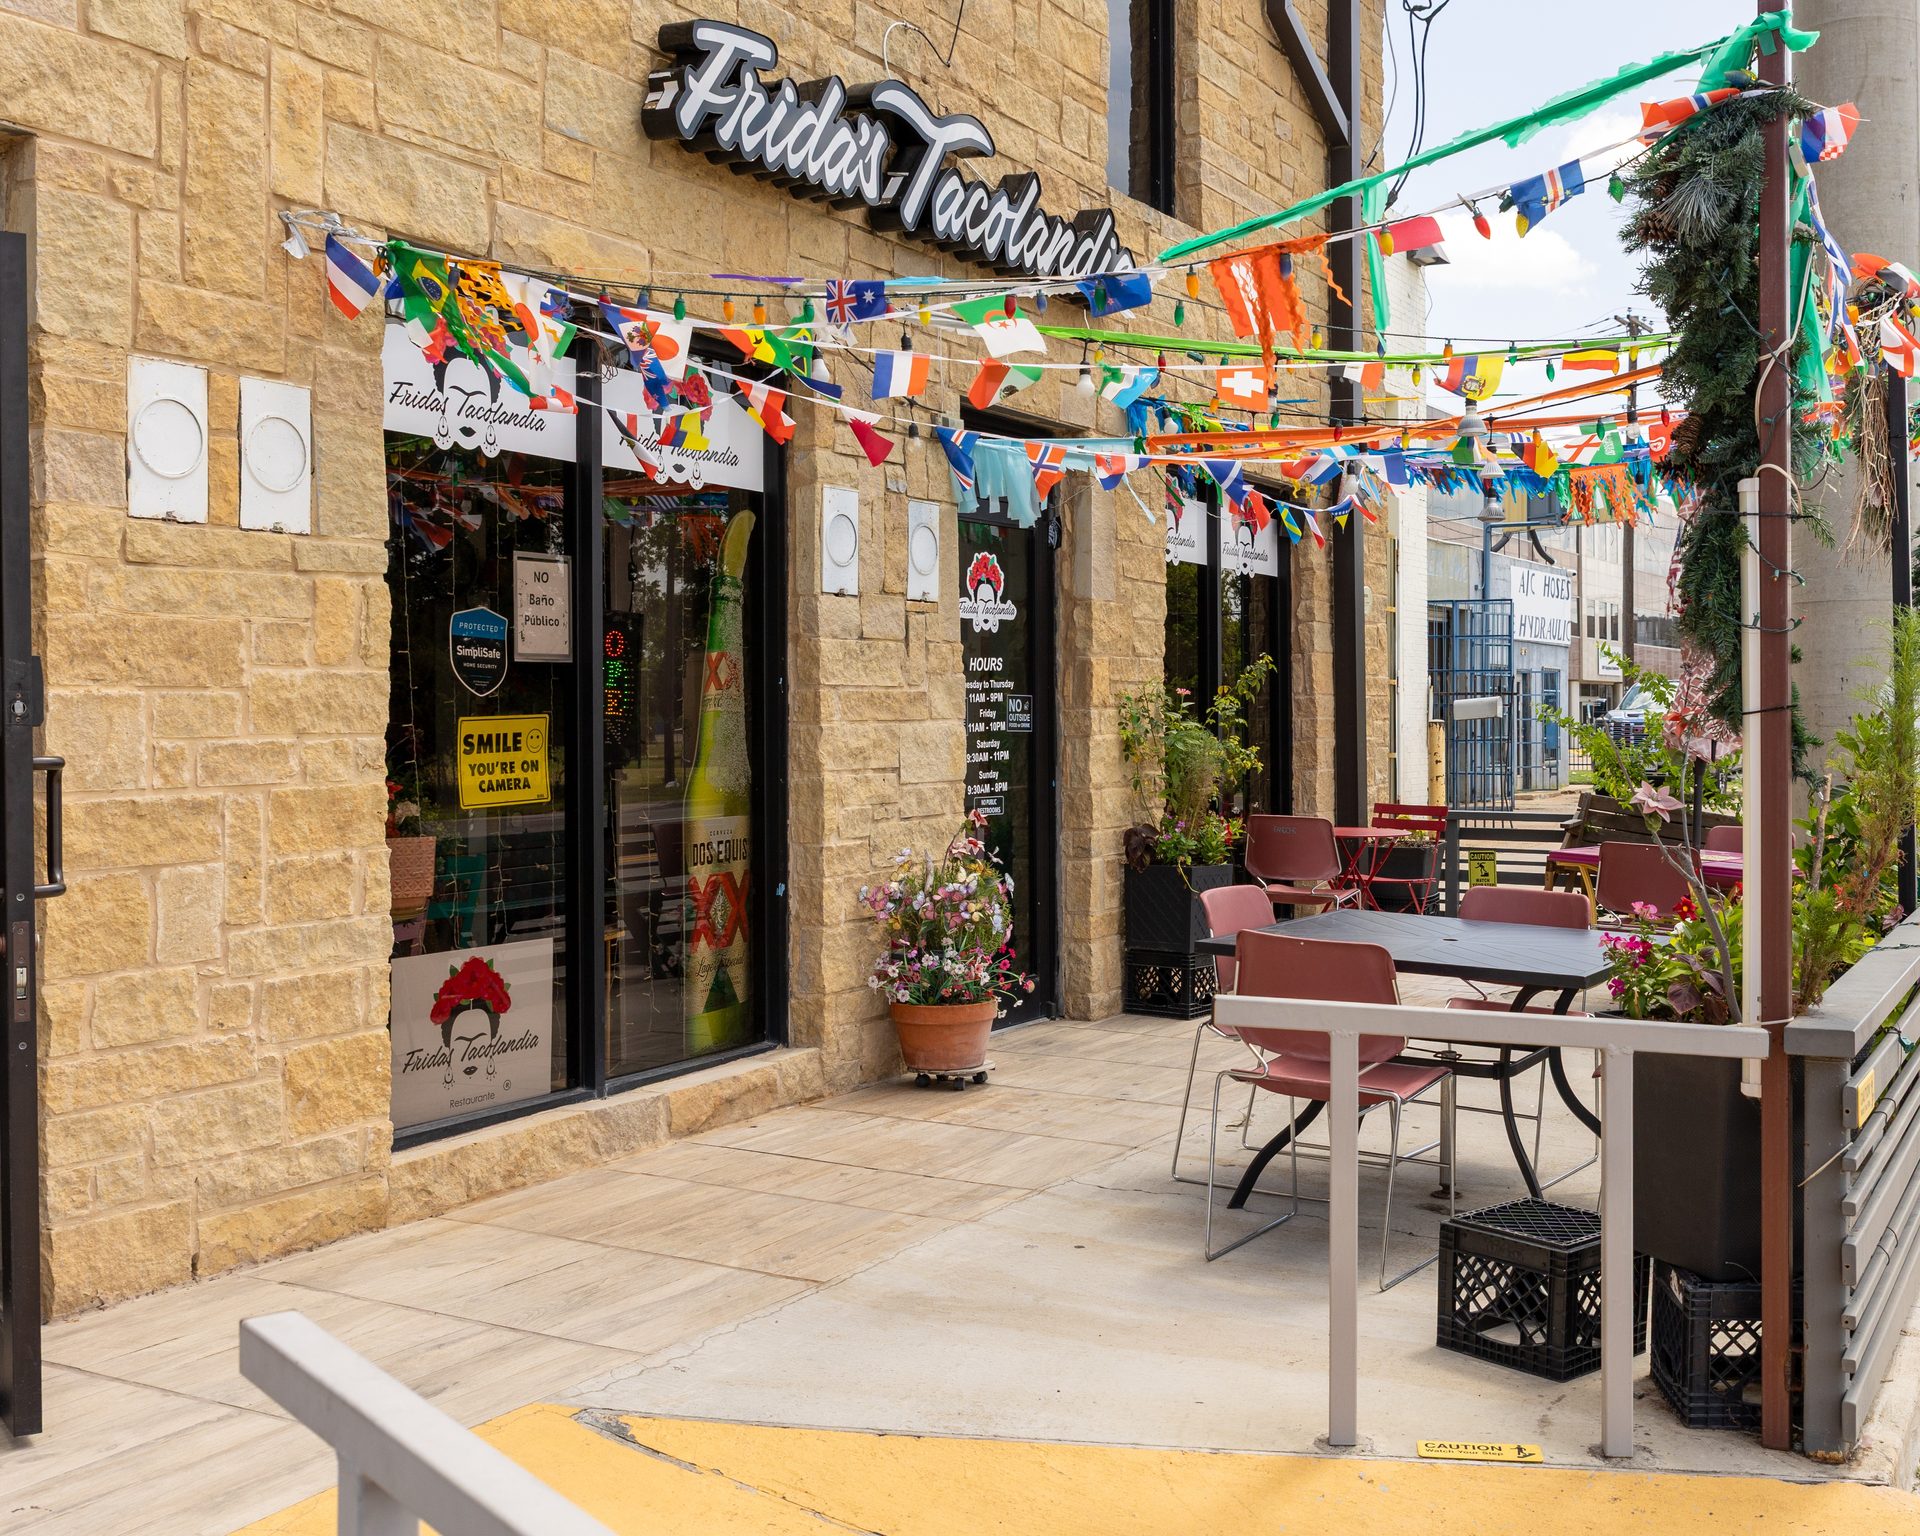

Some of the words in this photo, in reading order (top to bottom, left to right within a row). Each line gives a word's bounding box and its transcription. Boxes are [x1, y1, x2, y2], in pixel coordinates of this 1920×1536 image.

[680, 27, 879, 199] Frida's
[389, 381, 449, 416] Fridas
[454, 391, 547, 432] Tacolandia
[533, 571, 549, 583] NO
[1519, 570, 1535, 597] A/C
[1543, 575, 1571, 601] HOSES
[529, 593, 555, 606] Baño
[459, 621, 499, 633] PROTECTED
[524, 614, 560, 627] Público
[1518, 614, 1571, 642] HYDRAULIC
[456, 645, 501, 659] SimpliSafe
[969, 657, 1003, 672] HOURS
[984, 680, 989, 688] to
[990, 679, 1014, 690] Thursday
[969, 693, 985, 703] 11AM
[990, 692, 1003, 702] 9PM
[1008, 698, 1022, 712] NO
[979, 709, 996, 719] Friday
[1009, 713, 1031, 722] OUTSIDE
[968, 722, 985, 733] 11AM
[990, 721, 1006, 732] 10PM
[462, 732, 522, 756] SMILE
[976, 739, 1000, 749] Saturday
[966, 752, 989, 763] 9:30AM
[993, 750, 1010, 761] 11PM
[468, 761, 516, 777] YOU'RE
[521, 759, 539, 773] ON
[979, 769, 999, 780] Sunday
[478, 777, 531, 793] CAMERA
[967, 783, 991, 795] 9:30AM
[995, 781, 1008, 792] 8PM
[692, 841, 714, 867] DOS
[717, 837, 748, 863] EQUIS
[402, 1045, 455, 1074] Fridas
[458, 1029, 539, 1062] Tacolandia
[449, 1091, 496, 1109] Restaurante
[1424, 1442, 1502, 1452] CAUTION
